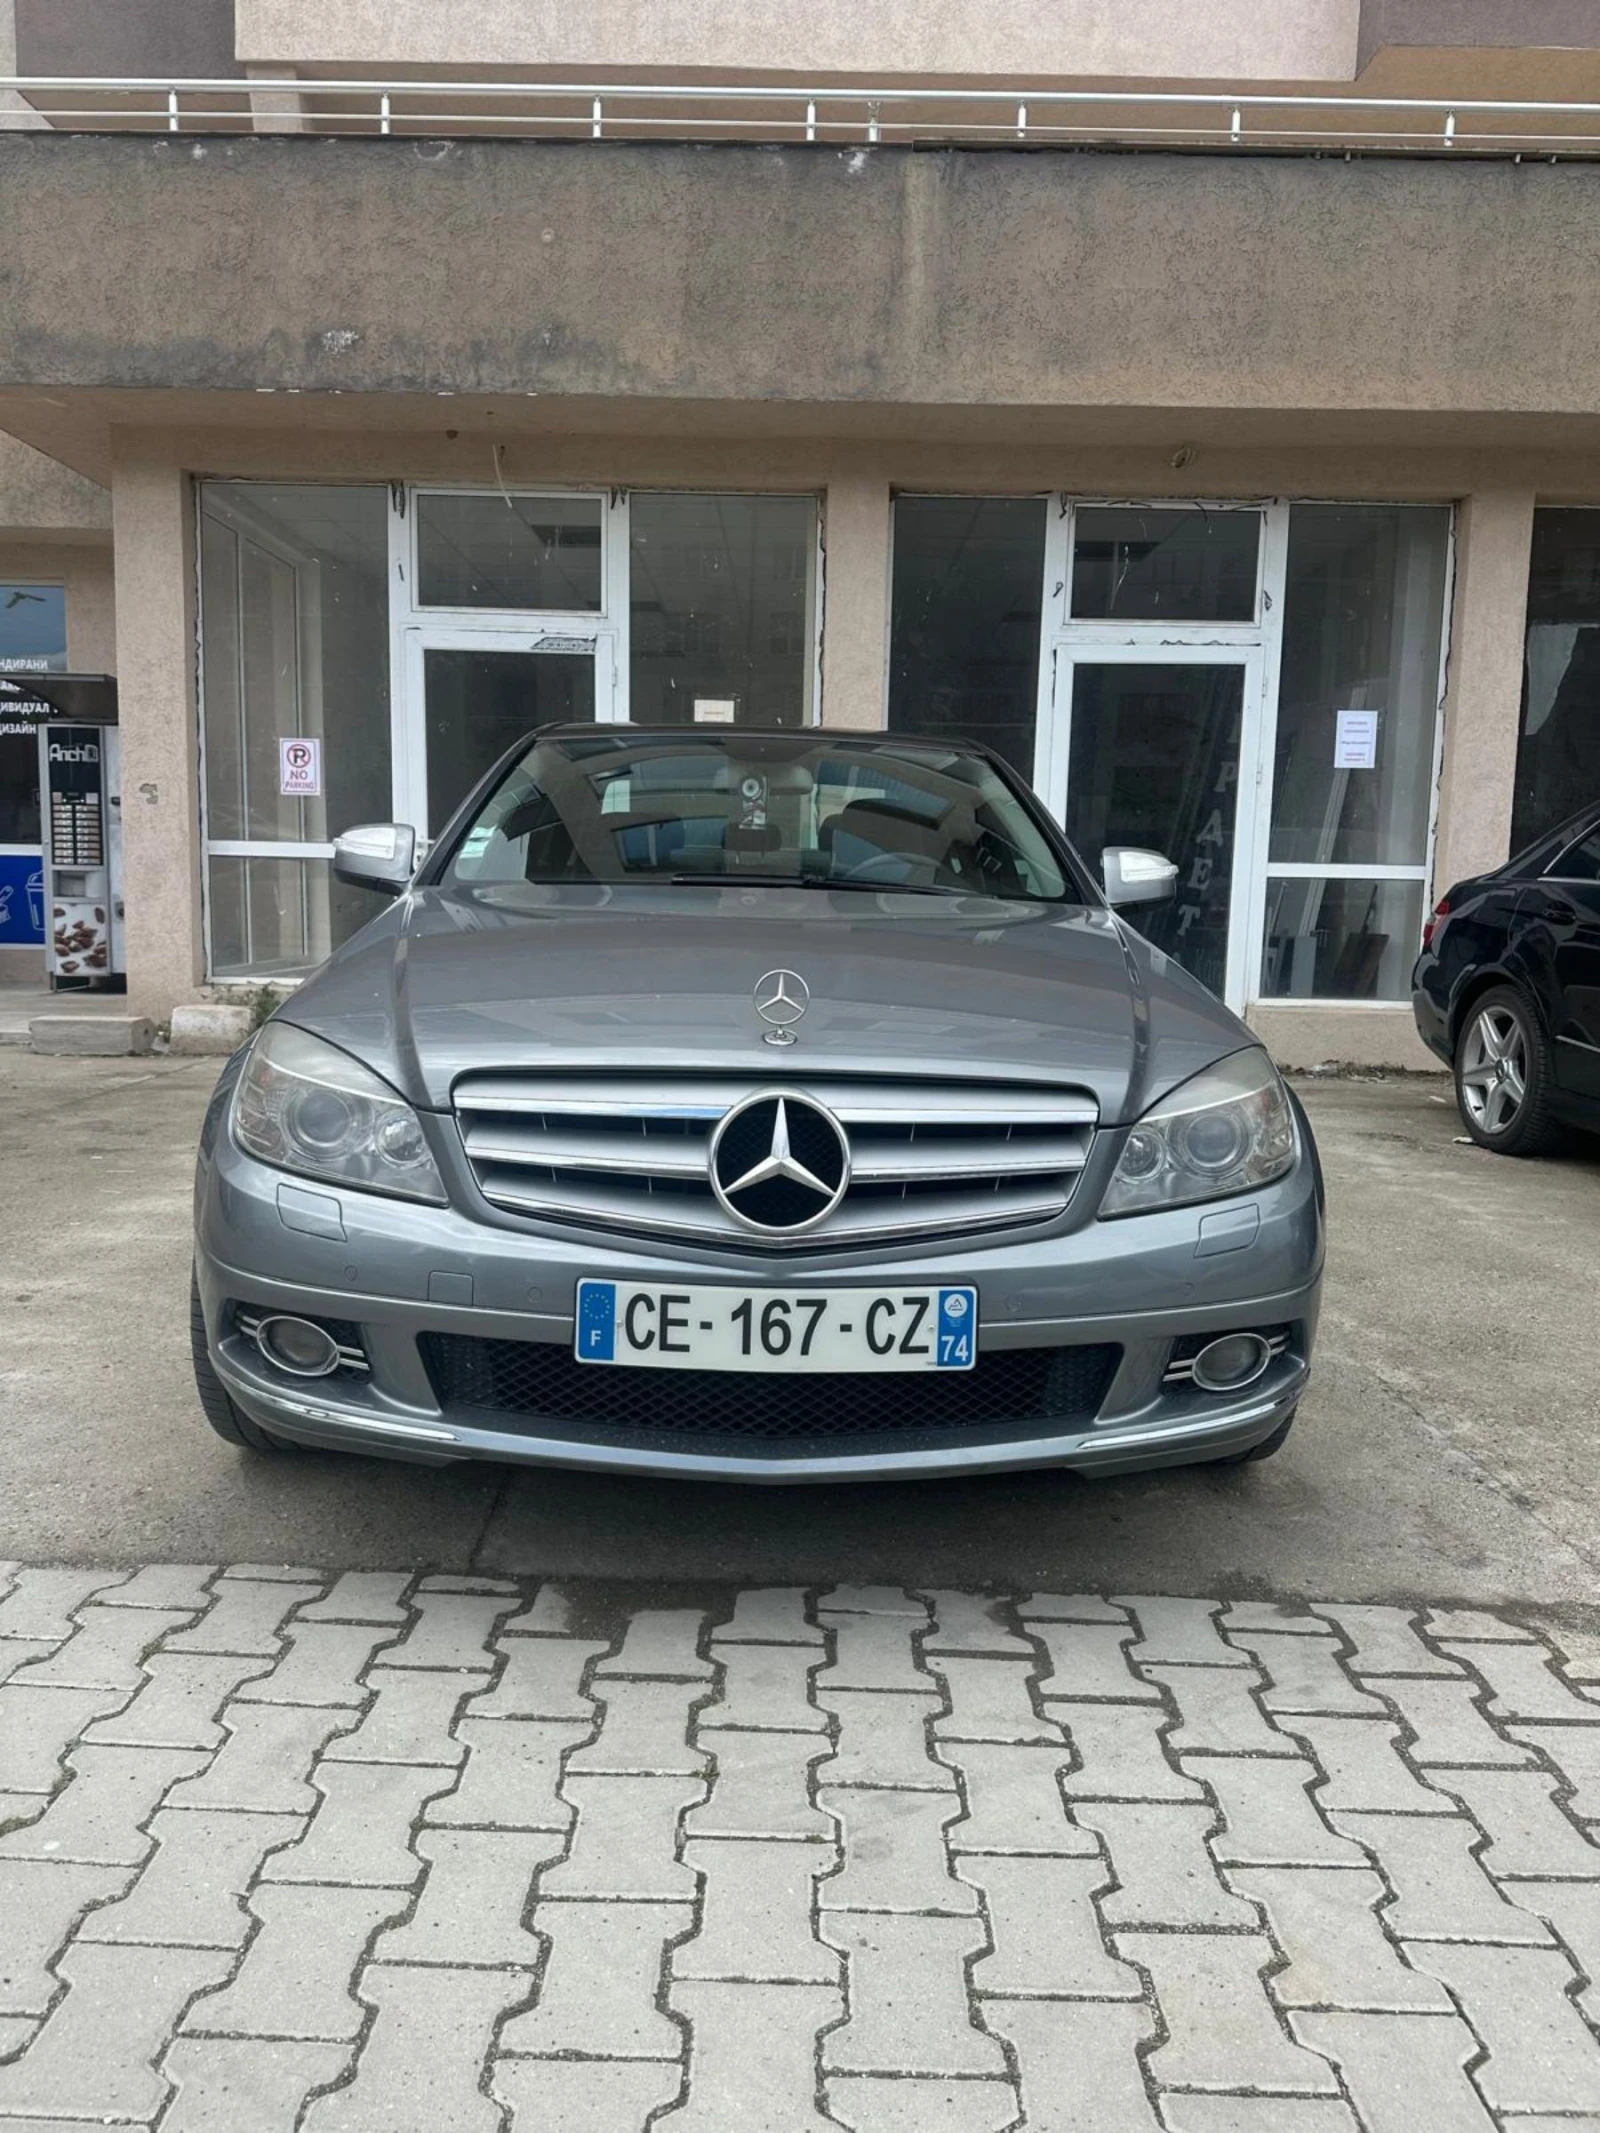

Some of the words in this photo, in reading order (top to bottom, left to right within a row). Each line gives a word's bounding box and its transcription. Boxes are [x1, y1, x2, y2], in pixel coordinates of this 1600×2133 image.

[290, 770, 308, 780] NO
[285, 781, 313, 789] PARKING
[590, 1329, 602, 1347] F
[941, 1334, 969, 1362] 74
